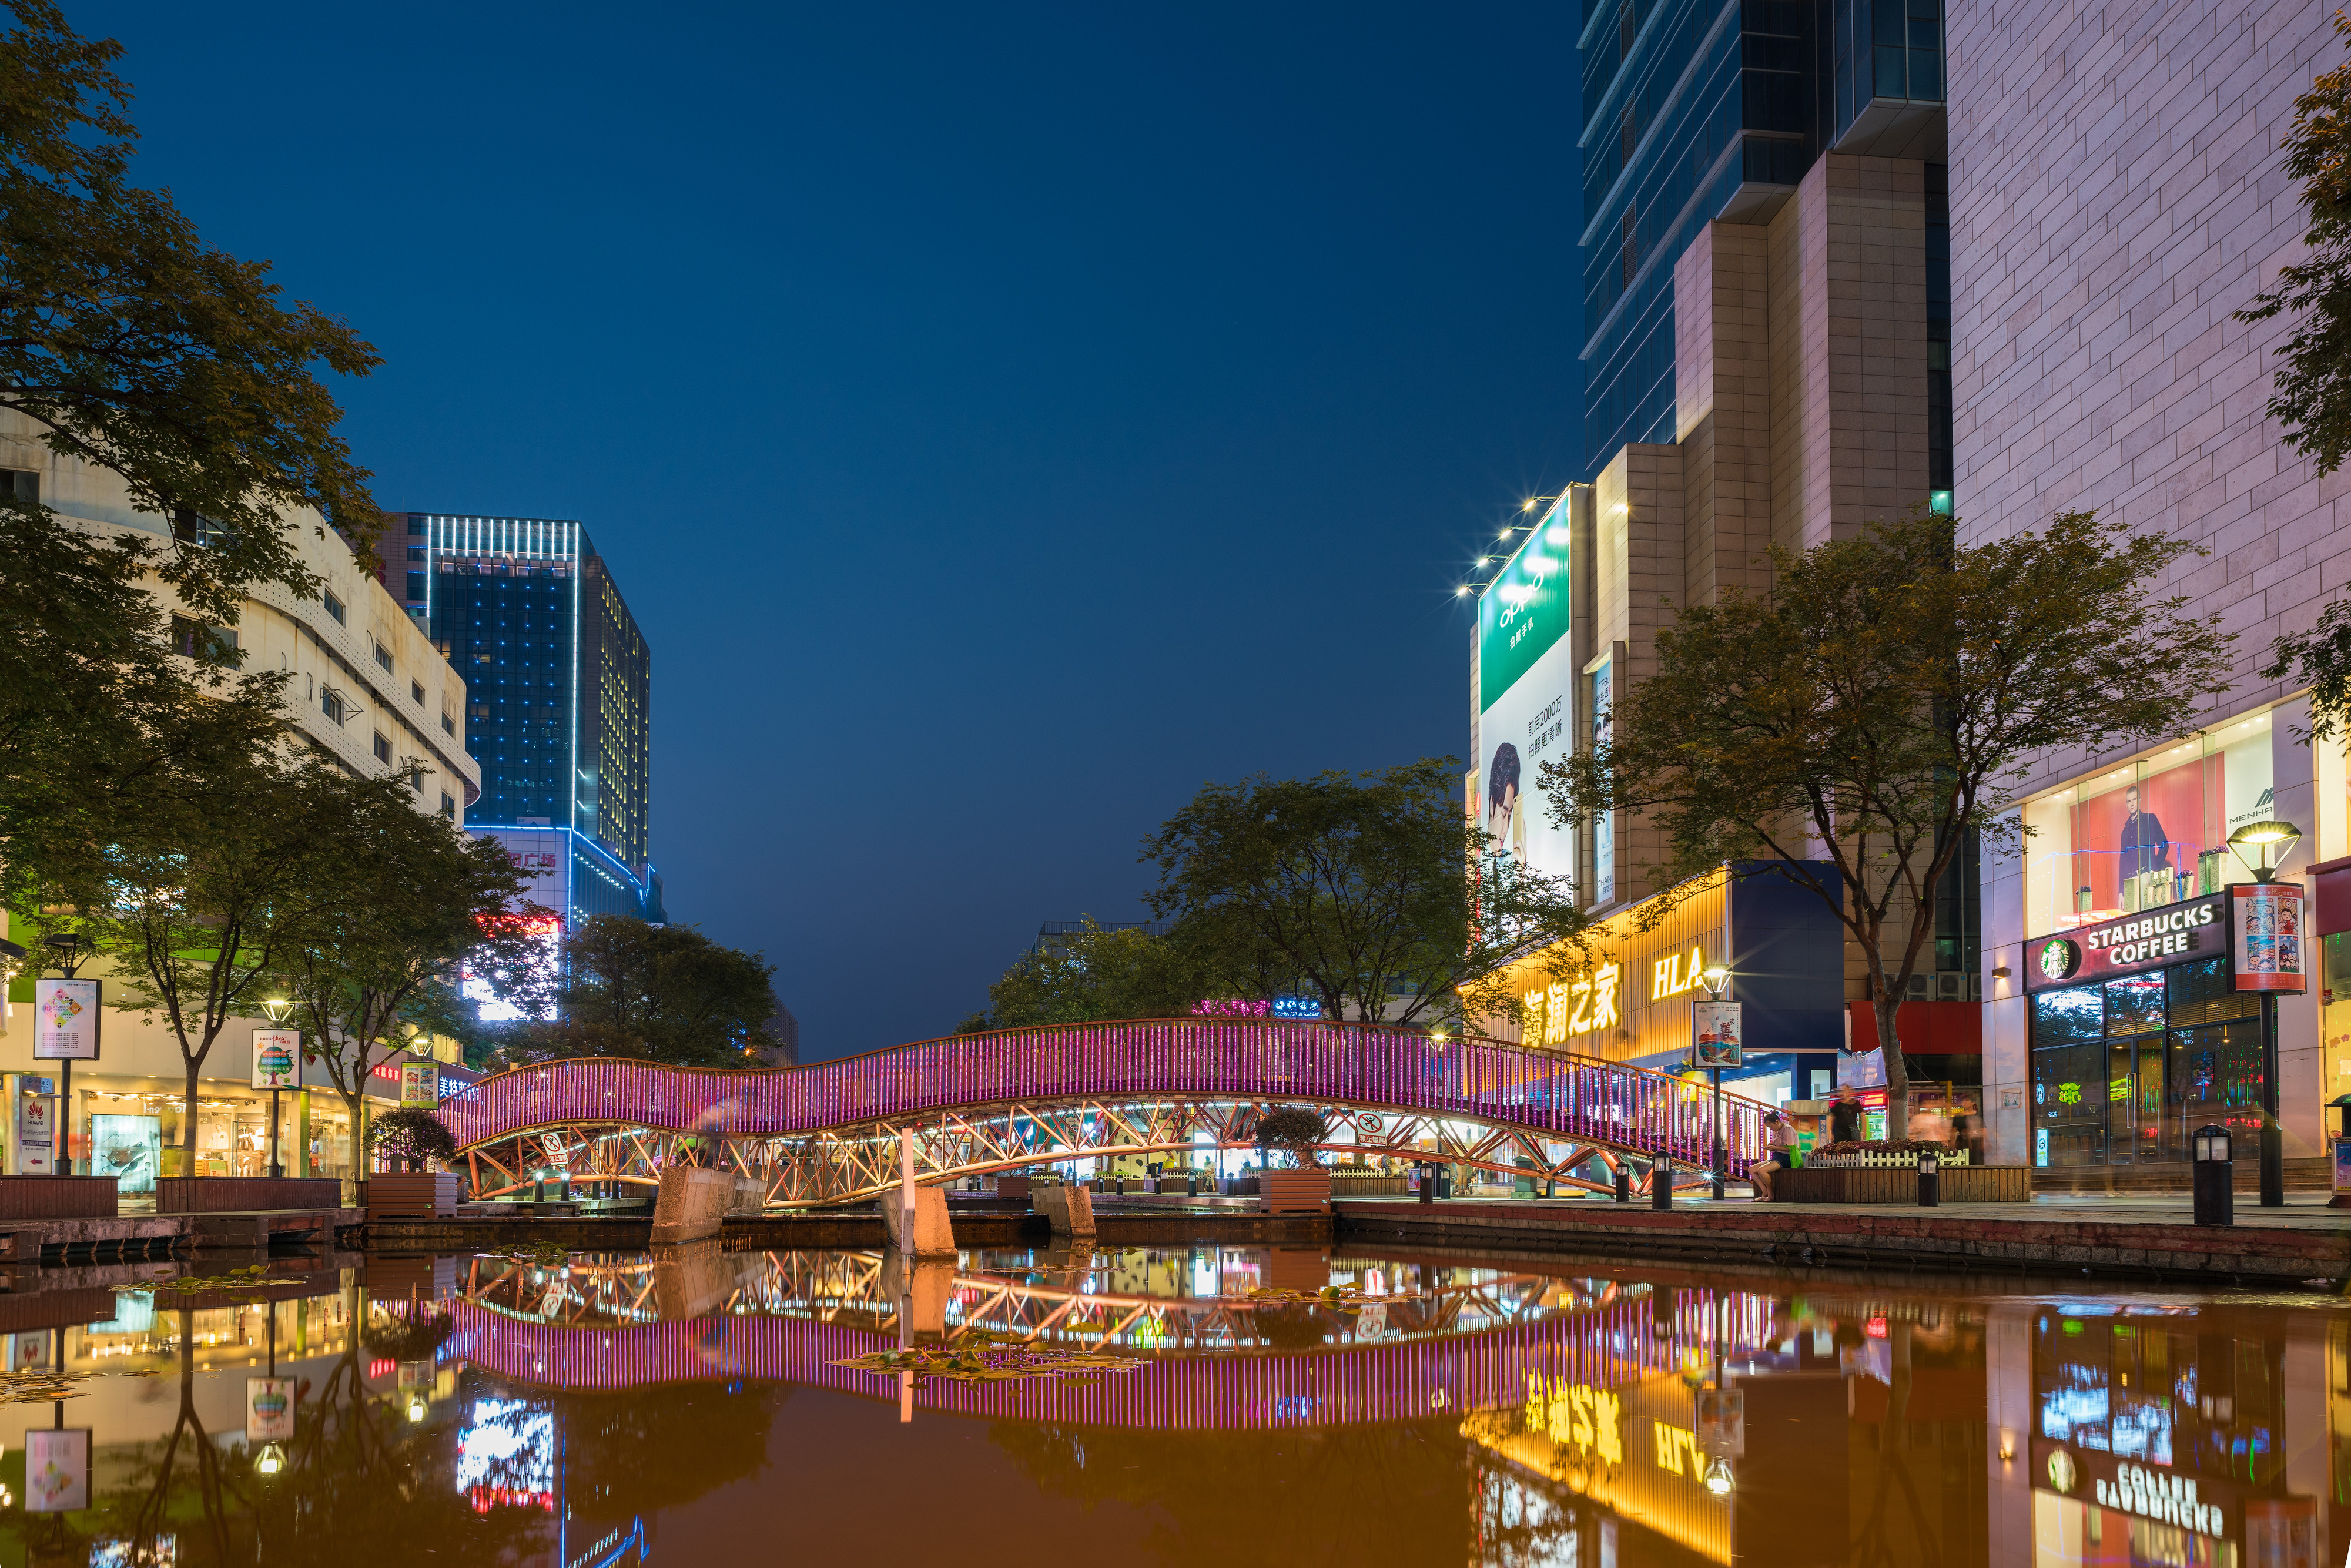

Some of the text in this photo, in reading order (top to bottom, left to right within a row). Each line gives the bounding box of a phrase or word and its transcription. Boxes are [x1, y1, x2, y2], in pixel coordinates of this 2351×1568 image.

[1510, 617, 1533, 651] 拍照手机
[1528, 695, 1562, 738] 前后2000万
[1528, 719, 1562, 760] 拍照更清晰
[495, 852, 556, 868] 阳广场
[1597, 875, 1612, 888] CHAN
[2254, 887, 2293, 896] 社会主义核心价值观
[2088, 904, 2212, 950] STARBUCKS
[2109, 932, 2188, 965] COFFEE
[1652, 947, 1703, 1000] HLA
[1522, 960, 1620, 1047] 海澜之家
[1359, 1135, 1385, 1144] 禁止攀爬
